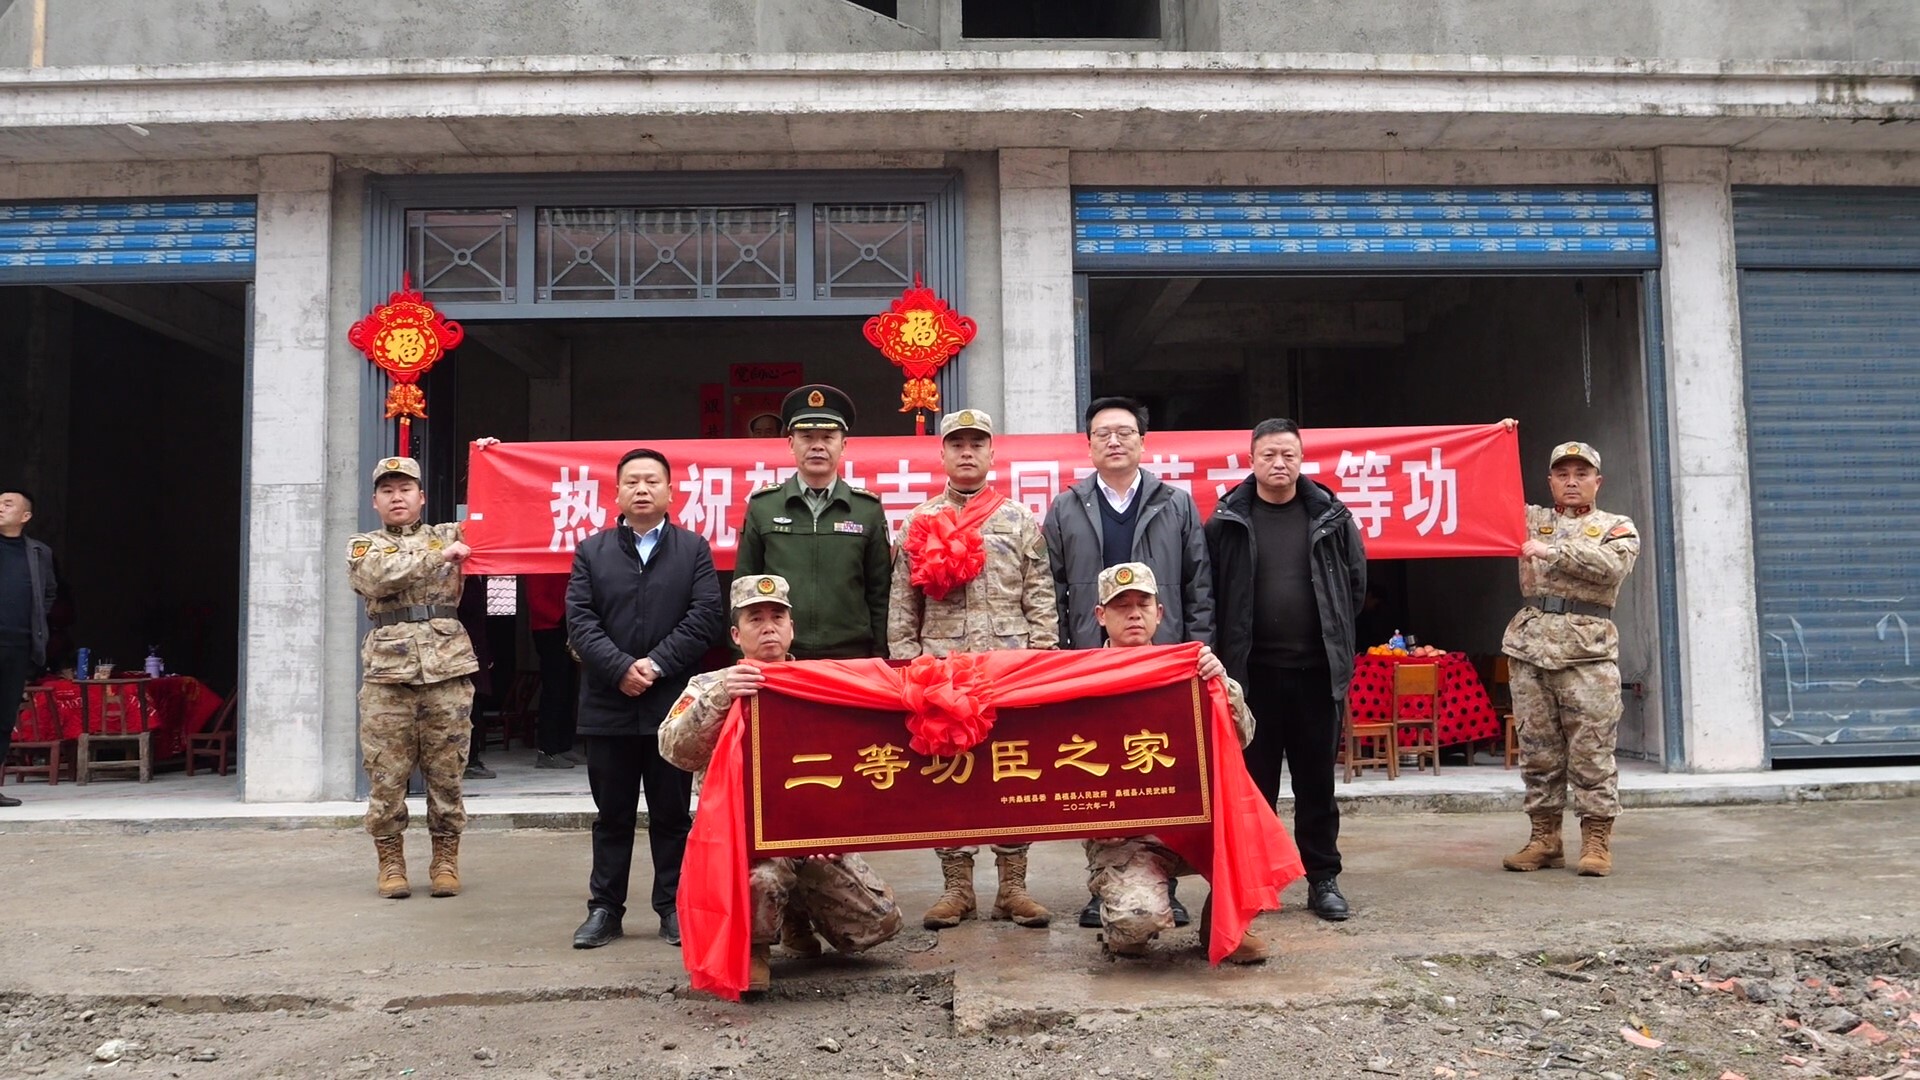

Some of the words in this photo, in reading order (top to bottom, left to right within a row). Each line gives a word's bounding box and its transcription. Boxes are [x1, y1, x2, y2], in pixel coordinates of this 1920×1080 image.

[384, 327, 426, 363] 福
[900, 310, 937, 347] 福
[784, 728, 1177, 790] 二等功臣之家
[1000, 793, 1047, 805] 中共桑植县委
[1054, 790, 1108, 801] 桑植县人民政府
[1115, 786, 1176, 798] 桑植县人民武装部
